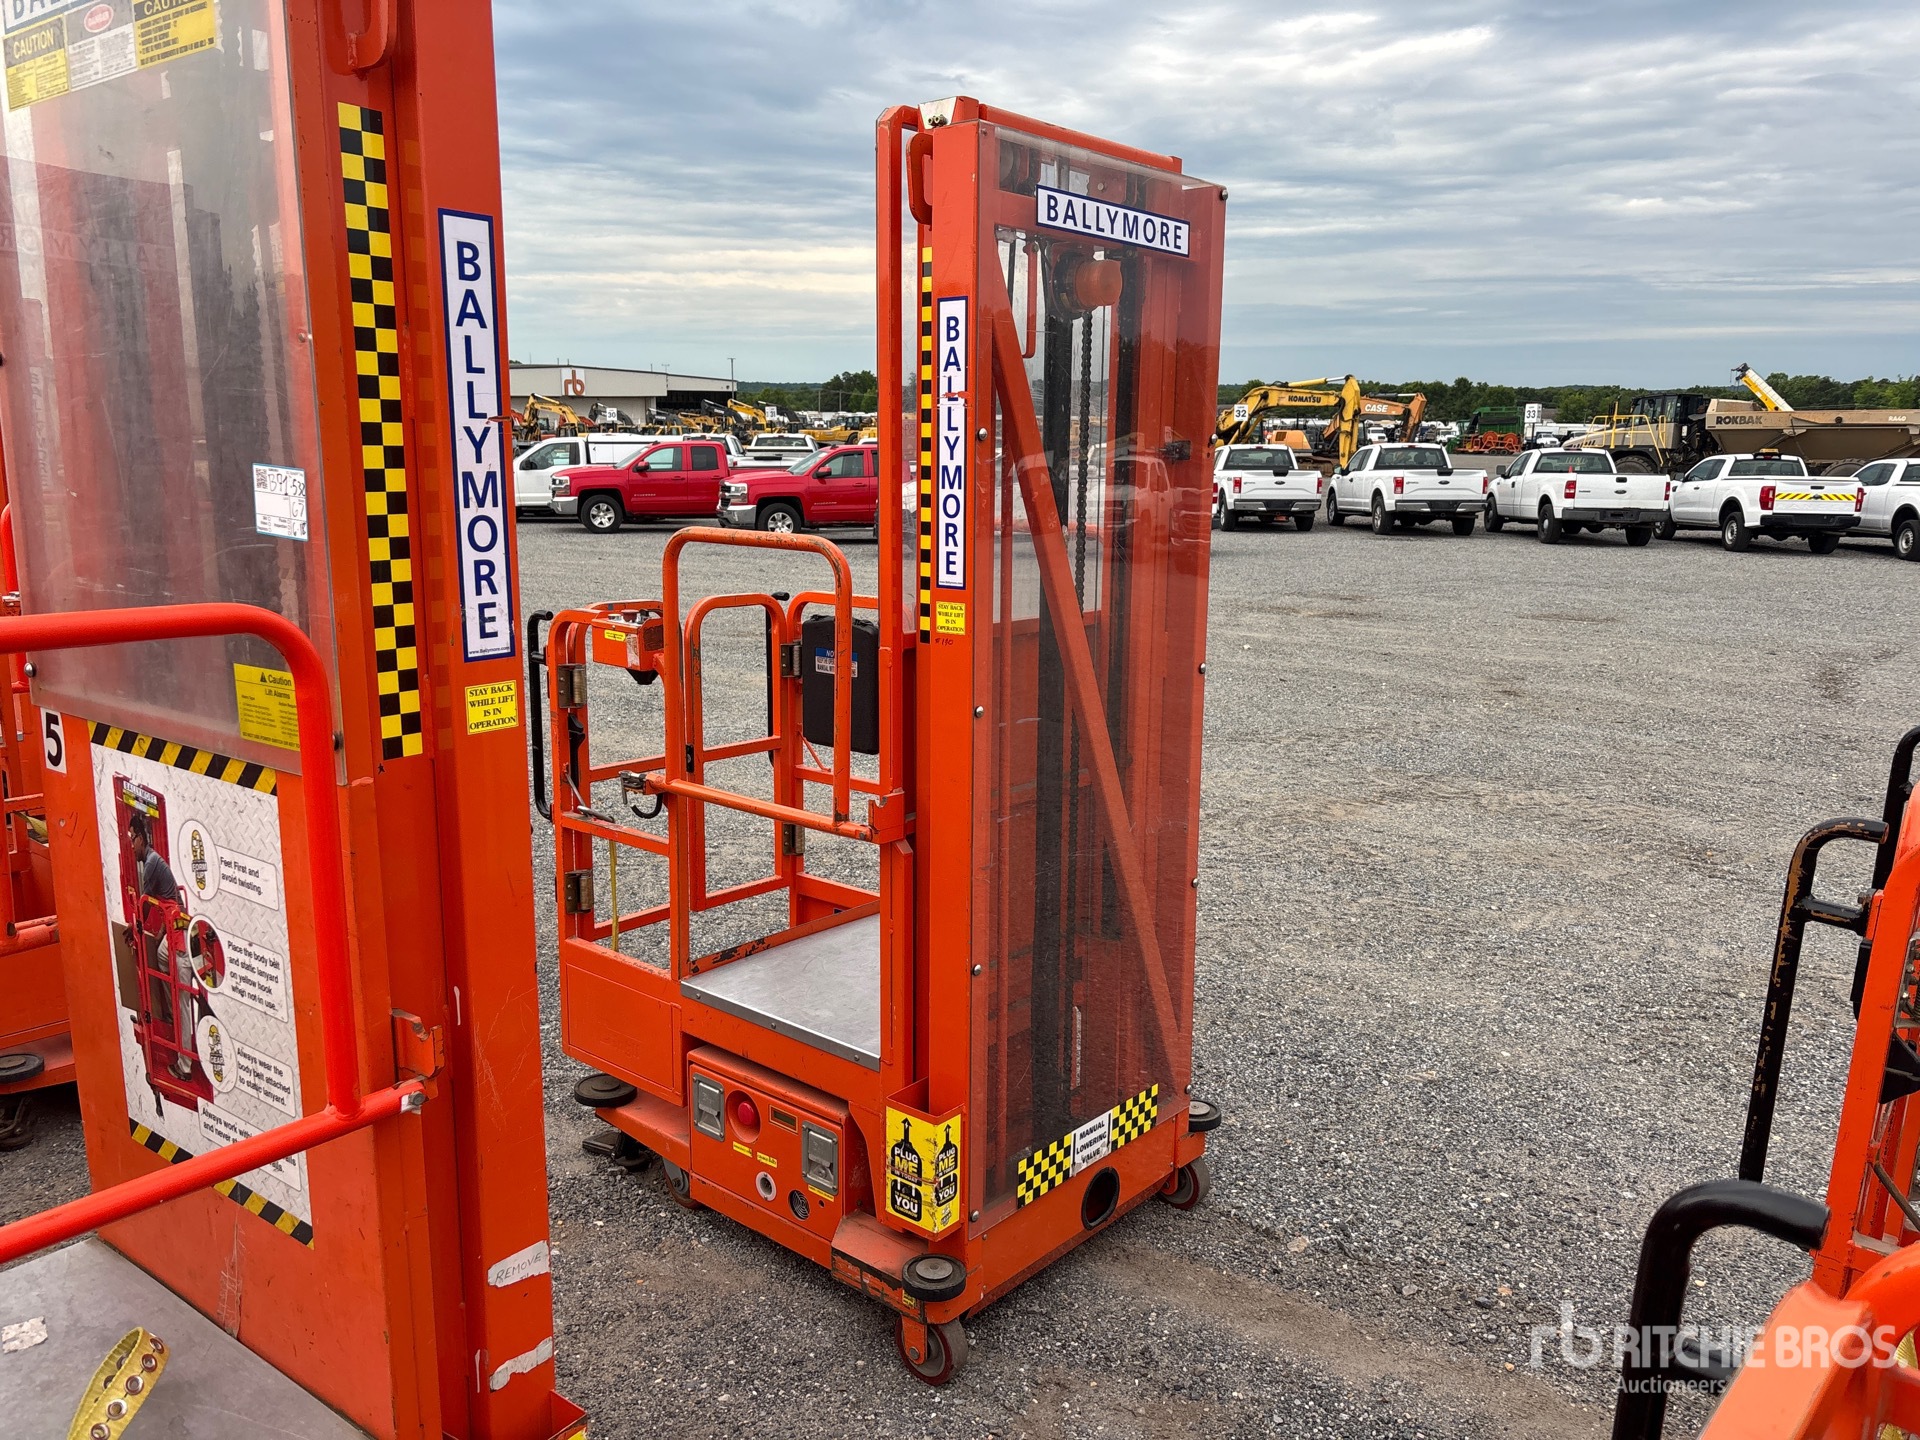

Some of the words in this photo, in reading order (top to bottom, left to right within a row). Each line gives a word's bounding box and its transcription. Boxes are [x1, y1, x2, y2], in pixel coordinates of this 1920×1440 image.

[14, 28, 54, 59] CAUTION
[1046, 194, 1182, 250] BALLYMORE
[564, 370, 585, 396] rb
[1288, 395, 1322, 403] KOMATSU
[1365, 404, 1388, 413] CASE
[608, 411, 616, 419] 30
[1235, 409, 1247, 418] 32
[1526, 409, 1537, 419] 33
[1715, 415, 1763, 425] ROKBAK
[456, 241, 498, 639] BALLYMORE
[942, 316, 961, 575] BALLYMORE
[268, 674, 292, 686] Caution
[273, 690, 291, 699] Alarms
[469, 687, 489, 697] STAY
[491, 684, 513, 694] BACK
[469, 697, 496, 708] WHILE
[498, 694, 515, 704] LIFT
[483, 709, 491, 717] IS
[493, 707, 502, 715] IN
[469, 716, 516, 730] OPERATION
[46, 712, 63, 767] 5
[220, 856, 233, 868] Feet
[234, 861, 247, 873] First
[248, 867, 259, 878] and
[221, 873, 237, 884] avoid
[238, 878, 263, 895] twisting.
[227, 940, 243, 954] Place
[244, 948, 253, 958] the
[253, 951, 268, 967] body
[269, 957, 280, 970] belt
[229, 956, 240, 967] and
[240, 960, 256, 974] static
[257, 967, 279, 983] lanyard
[230, 970, 238, 980] on
[238, 974, 257, 988] yellow
[257, 981, 273, 995] hook
[231, 984, 247, 997] when
[247, 992, 257, 1002] not
[257, 995, 264, 1004] in
[264, 1000, 278, 1012] use.
[237, 1047, 257, 1065] Always
[258, 1059, 273, 1071] wear
[273, 1065, 284, 1077] the
[237, 1061, 252, 1076] body
[253, 1067, 264, 1080] belt
[265, 1075, 291, 1095] attached
[239, 1075, 245, 1085] to
[246, 1080, 262, 1094] static
[263, 1086, 287, 1106] lanyard.
[202, 1107, 222, 1125] Always
[223, 1119, 237, 1134] work
[1079, 1120, 1105, 1140] MANUAL
[203, 1121, 214, 1133] and
[215, 1128, 231, 1142] never
[1076, 1131, 1107, 1155] LOWERING
[894, 1146, 918, 1164] PLUG
[939, 1147, 956, 1161] PLUG
[939, 1154, 956, 1173] ME
[1081, 1147, 1101, 1163] VALVE
[895, 1156, 918, 1176] ME
[939, 1185, 955, 1201] YOU
[894, 1195, 918, 1214] YOU
[495, 1252, 542, 1284] REMOVE
